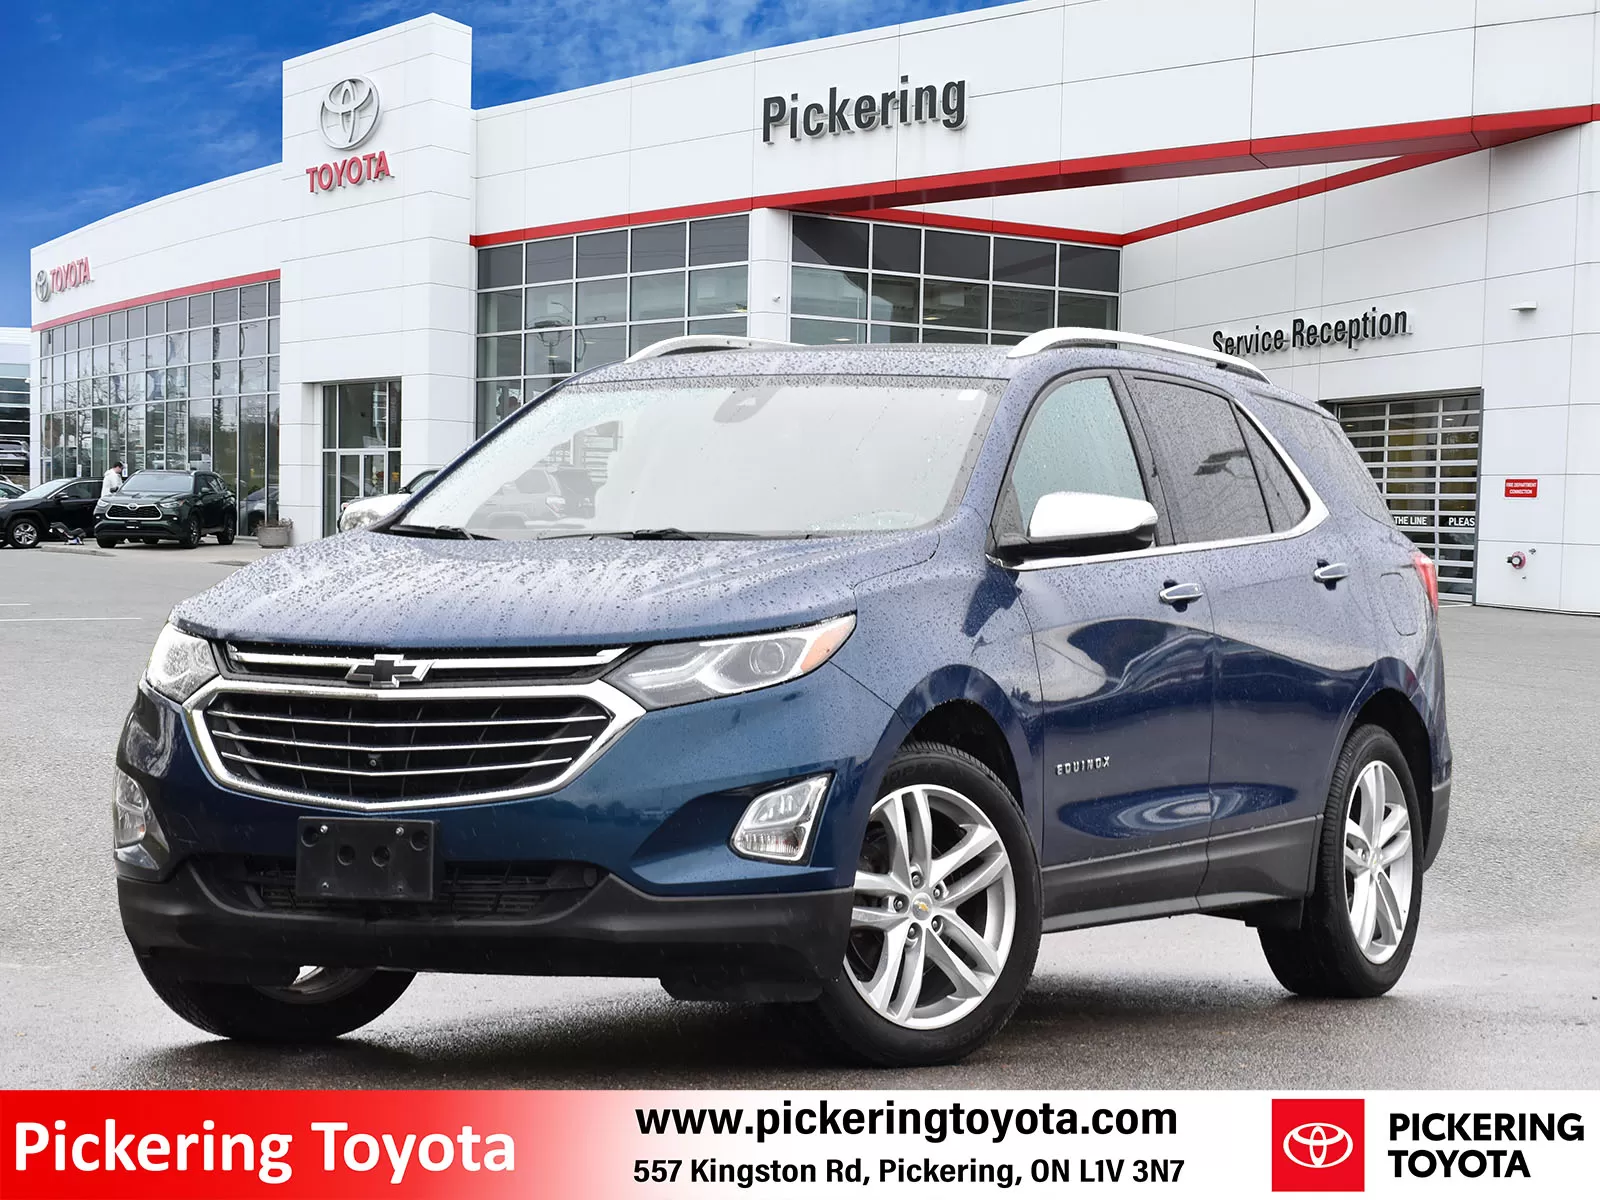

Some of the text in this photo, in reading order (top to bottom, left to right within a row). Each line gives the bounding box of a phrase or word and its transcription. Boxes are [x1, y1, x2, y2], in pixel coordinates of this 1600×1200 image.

[762, 75, 966, 143] Pickering
[306, 151, 391, 193] TOYOTA
[50, 256, 91, 293] TOYOTA
[1212, 306, 1408, 355] Service Reception
[1394, 516, 1408, 525] THE
[1410, 516, 1427, 525] LINE
[1056, 756, 1110, 775] EQUINOX
